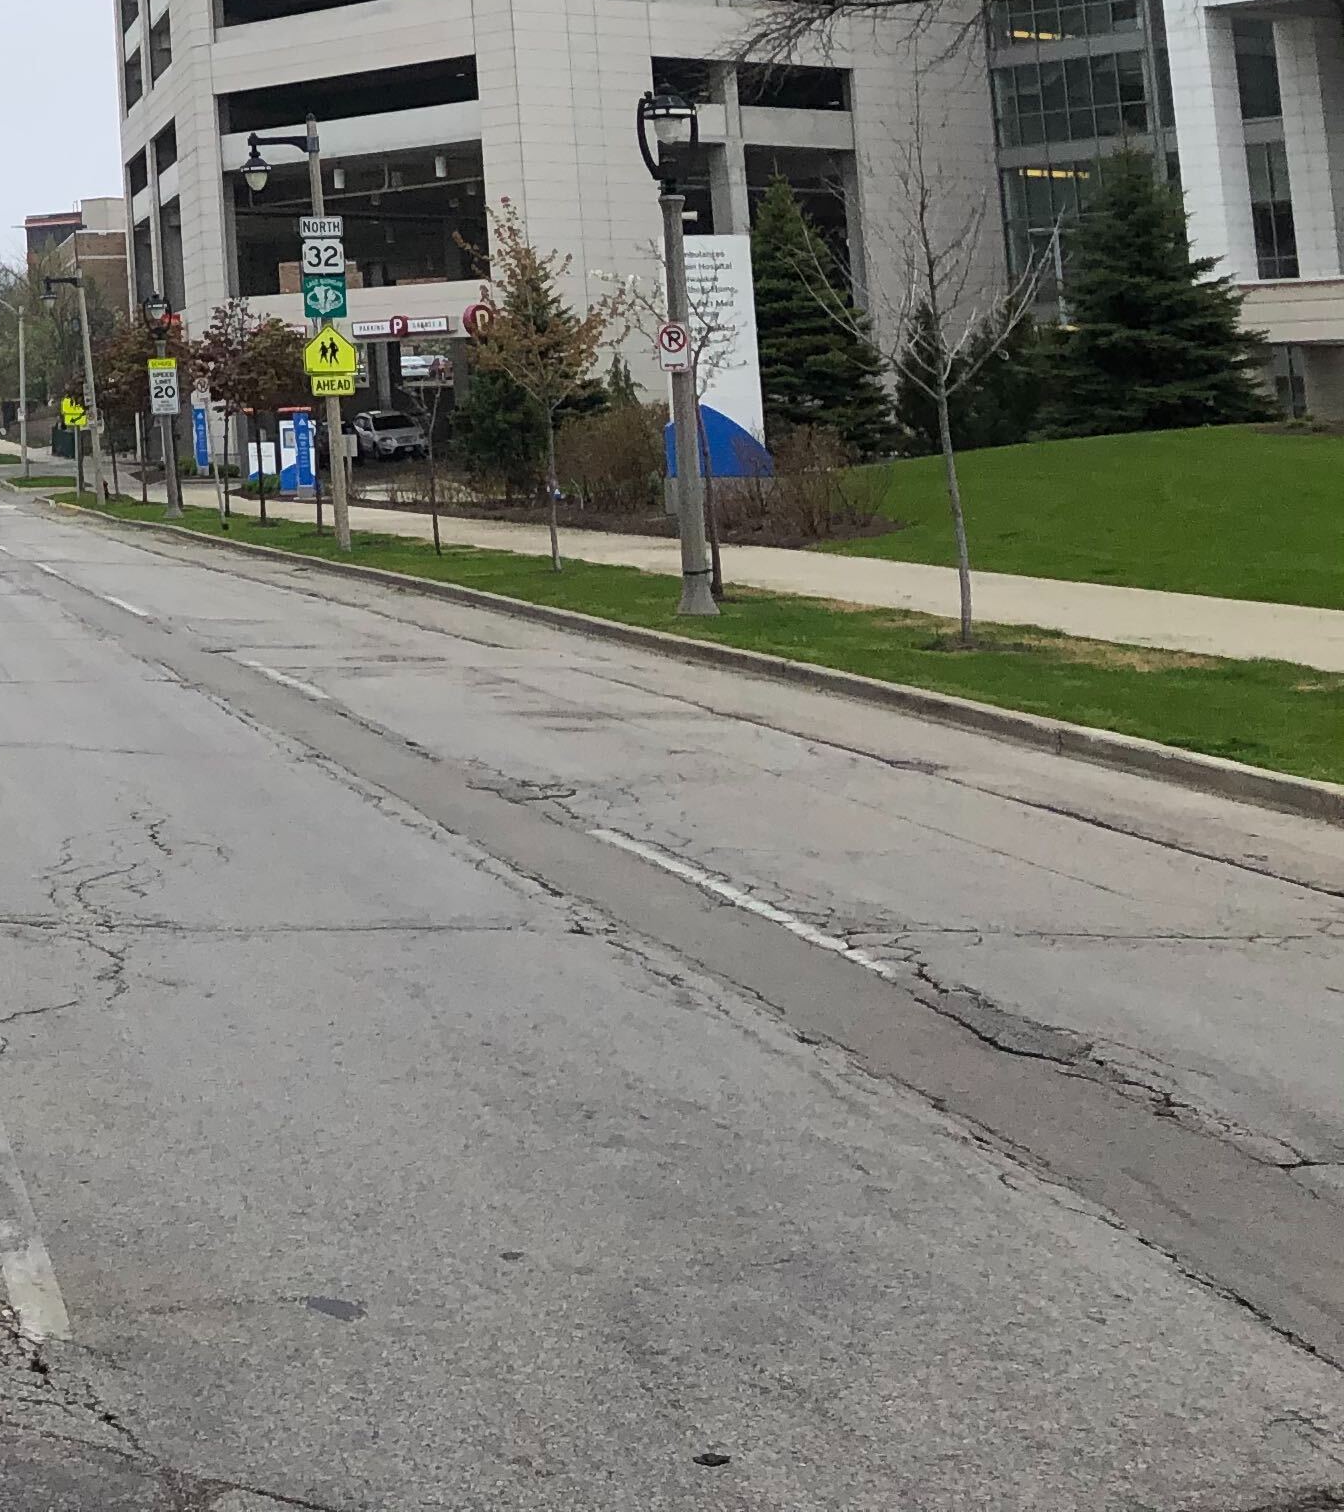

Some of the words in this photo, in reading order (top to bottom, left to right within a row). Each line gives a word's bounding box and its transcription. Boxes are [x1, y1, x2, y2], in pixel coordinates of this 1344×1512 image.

[302, 220, 341, 233] NORTH
[306, 245, 340, 268] 32
[315, 379, 351, 391] AHEAD
[153, 385, 176, 399] 20
